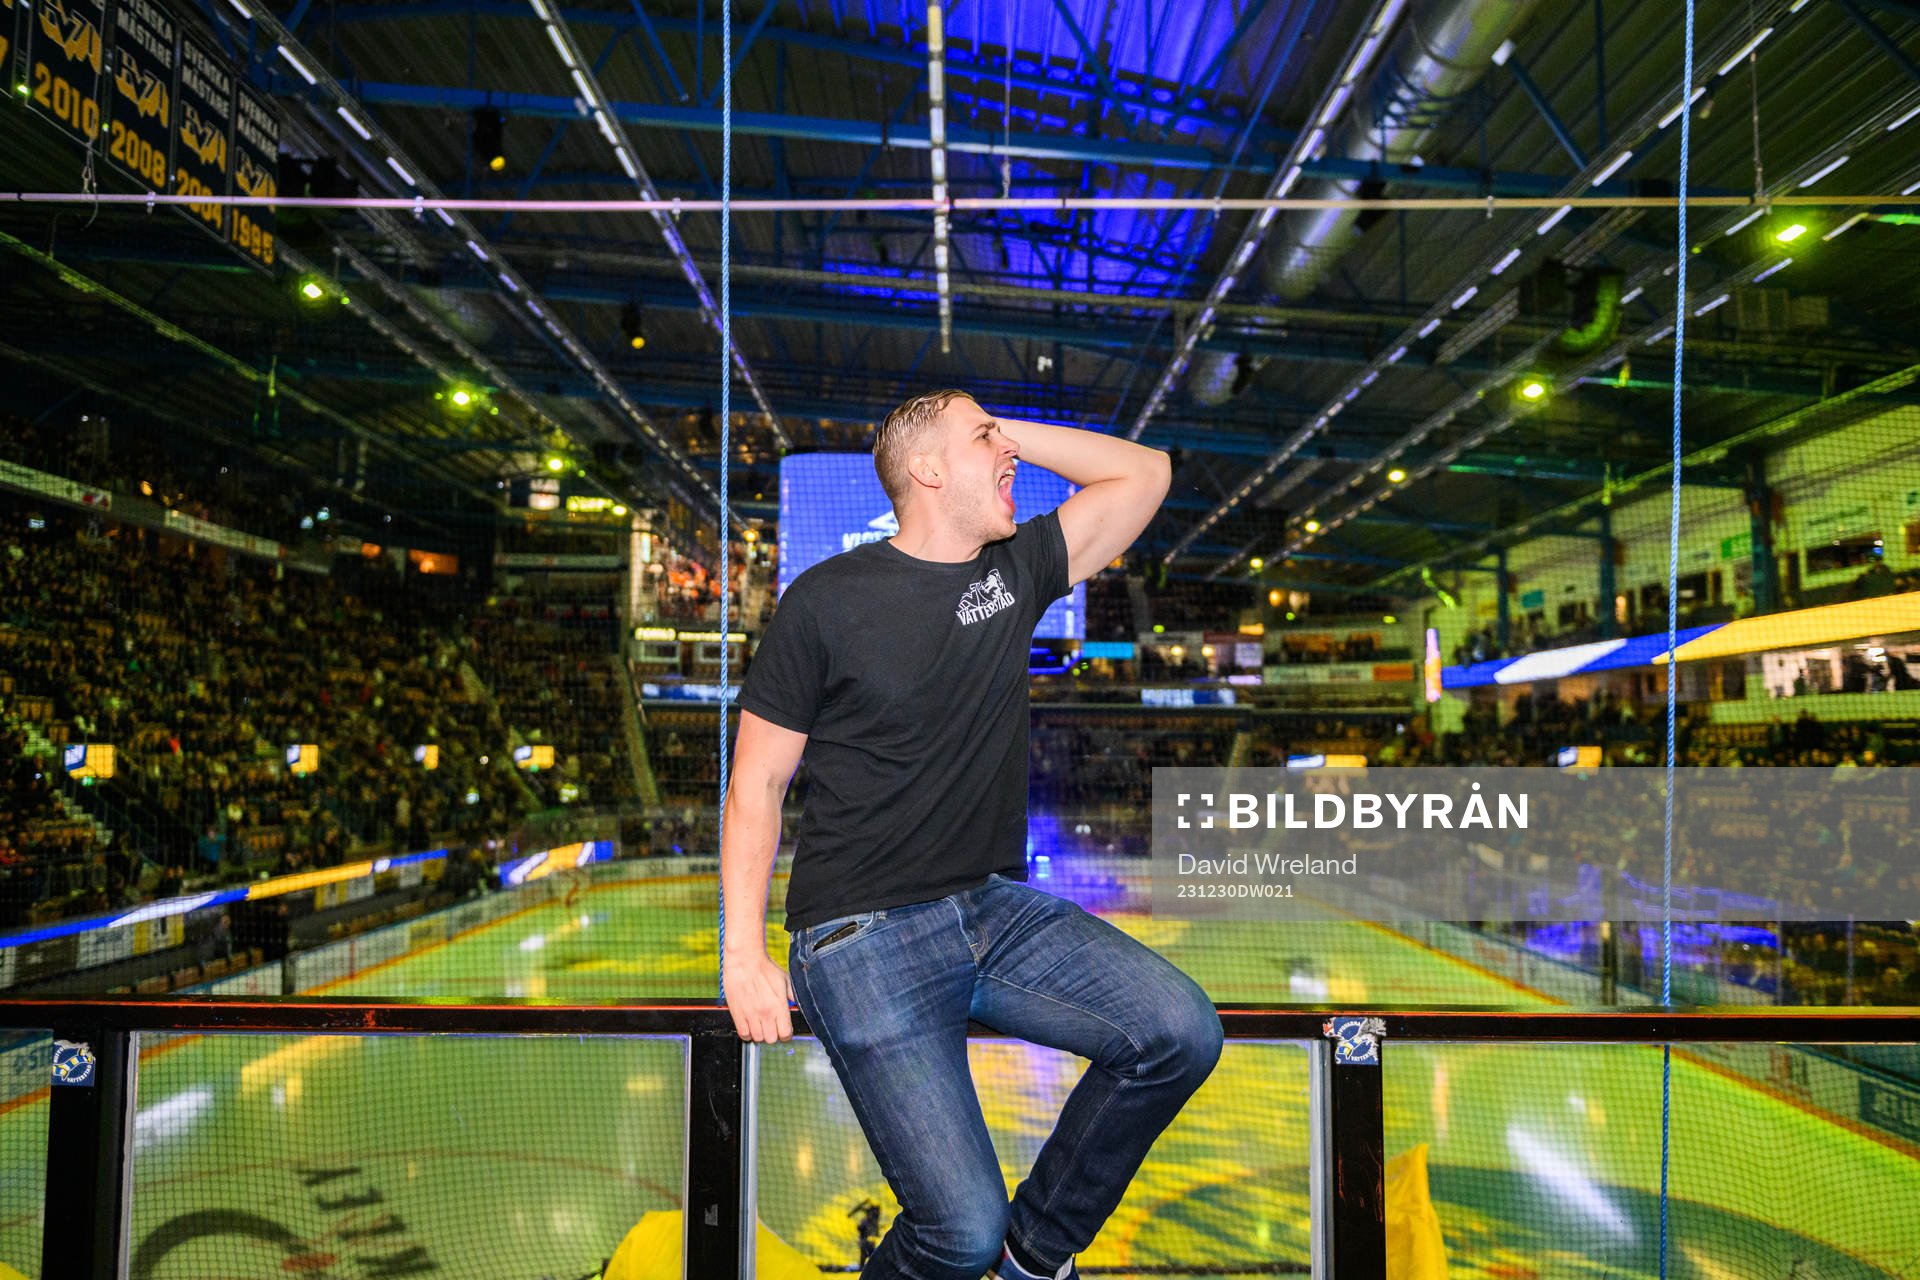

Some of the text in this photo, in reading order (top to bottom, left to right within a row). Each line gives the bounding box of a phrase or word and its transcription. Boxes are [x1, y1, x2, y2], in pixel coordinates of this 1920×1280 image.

[117, 7, 172, 70] MÄSTARE
[183, 38, 231, 97] SVENSKA
[33, 61, 100, 140] 2010
[181, 62, 230, 120] MÄSTARE
[110, 119, 166, 188] 2008
[176, 167, 223, 230] 2004
